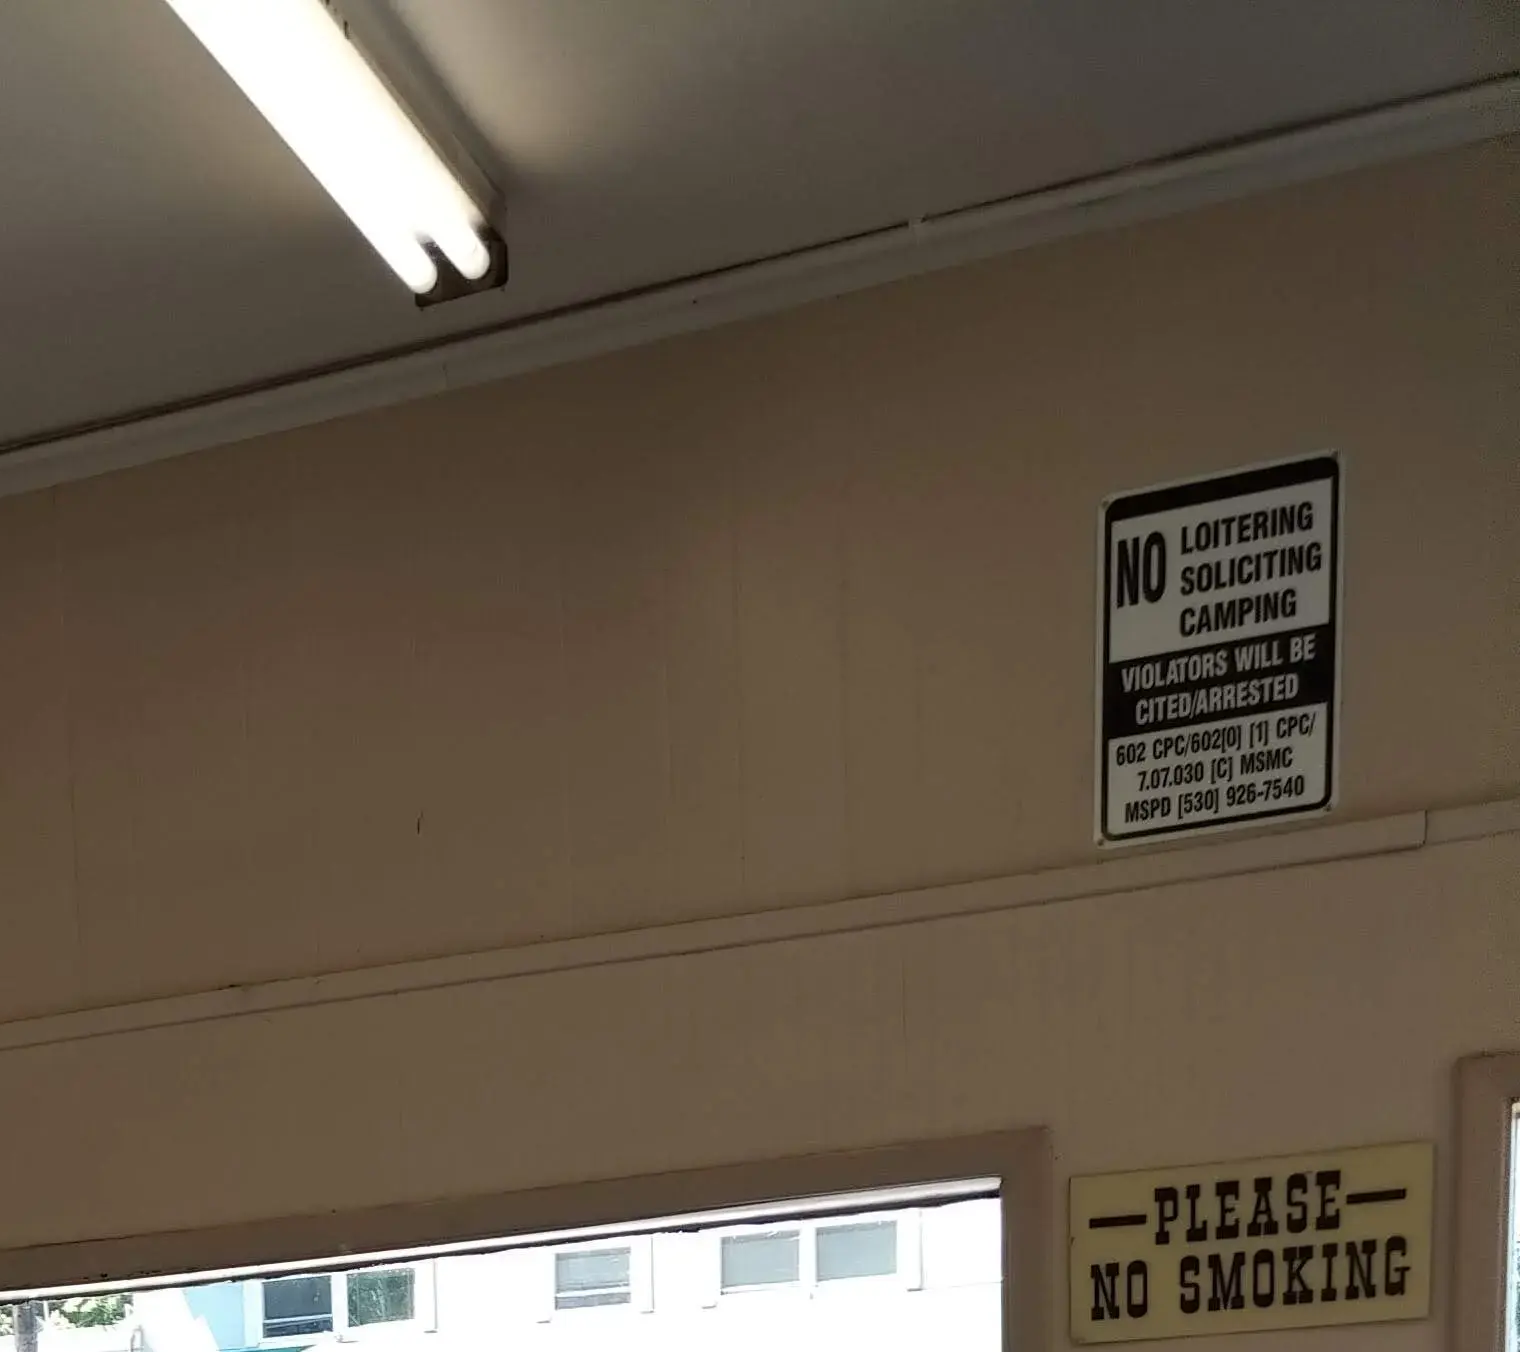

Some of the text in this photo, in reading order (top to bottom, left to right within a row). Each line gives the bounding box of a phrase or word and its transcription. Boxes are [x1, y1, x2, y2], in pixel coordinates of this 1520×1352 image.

[1180, 501, 1314, 556] LOITERING
[1116, 531, 1167, 610] NO
[1180, 542, 1322, 596] SOLICITING
[1179, 588, 1297, 638] CAMPING
[1121, 632, 1317, 693] VIOLATORS WILL BE
[1135, 672, 1300, 726] CITED/ARRESTED
[1115, 741, 1146, 767] 602
[1276, 712, 1317, 740] CPC/
[1137, 746, 1295, 792] 7.07.030 [C] MSMC
[1125, 774, 1306, 824] MSPD [530] 926-7540
[1154, 1169, 1342, 1246] PLEASE
[1089, 1235, 1412, 1322] NO SMOKING
